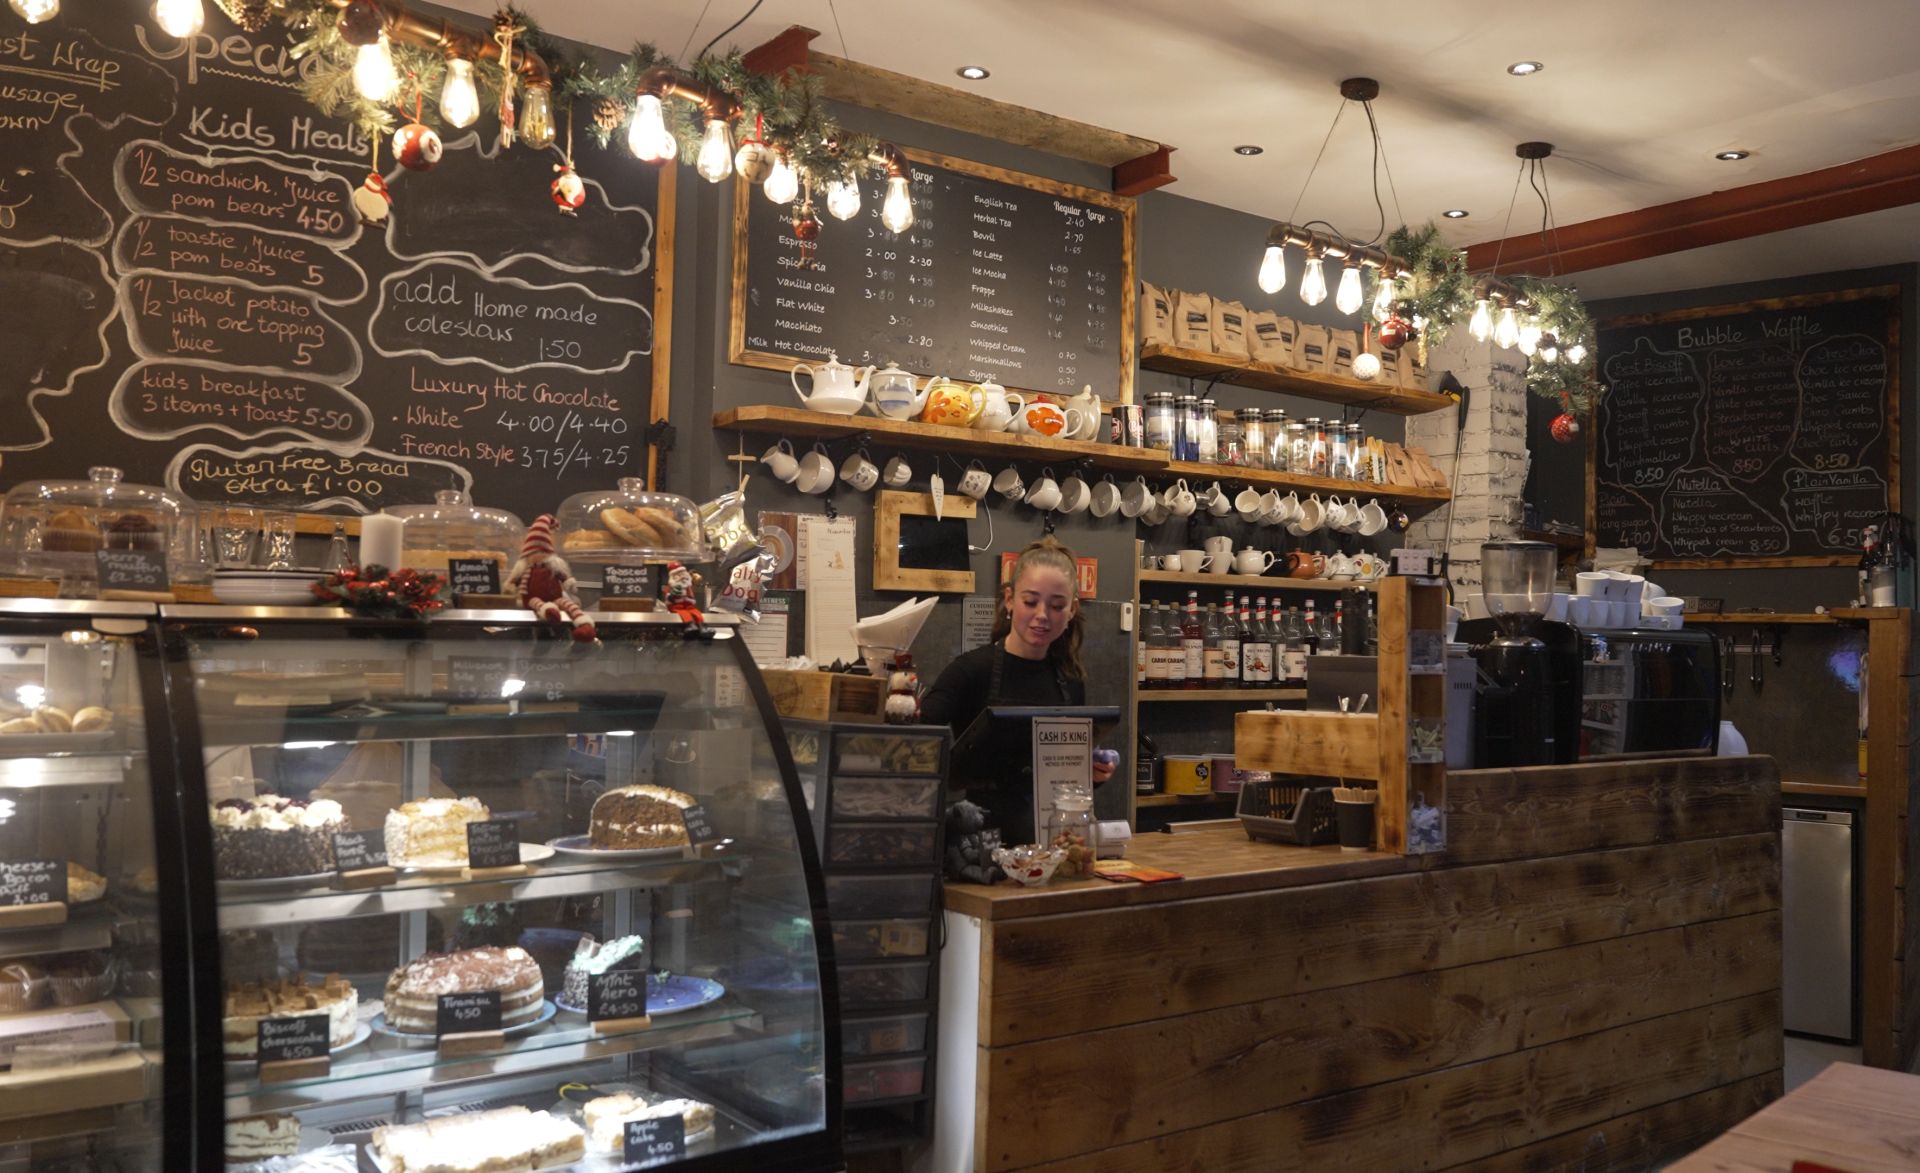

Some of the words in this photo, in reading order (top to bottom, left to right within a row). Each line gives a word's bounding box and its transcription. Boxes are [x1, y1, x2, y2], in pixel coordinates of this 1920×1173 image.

[52, 41, 120, 93] Wrap
[190, 106, 275, 145] Kids
[291, 116, 370, 156] Meals
[911, 168, 934, 184] Large
[974, 195, 1004, 209] English
[1005, 202, 1018, 212] Tea
[1053, 200, 1082, 216] Regular
[1086, 209, 1106, 223] Large
[172, 193, 215, 210] pom
[227, 198, 285, 219] bears
[296, 206, 344, 234] 4.50
[973, 213, 998, 225] Herbal
[999, 218, 1012, 228] Tea
[778, 235, 818, 250] Espresso
[972, 230, 996, 242] Bovril
[1064, 231, 1084, 243] 2.70
[865, 248, 897, 260] 2.00
[909, 256, 932, 267] 2.30
[972, 248, 983, 258] Ice
[984, 250, 1003, 262] Latte
[170, 250, 209, 269] pom
[220, 256, 276, 276] bears
[302, 264, 324, 286] 5
[972, 266, 982, 275] Ice
[983, 268, 1007, 280] Mocha
[777, 277, 812, 291] Vanilla
[814, 283, 835, 294] Chia
[971, 284, 996, 296] Frappe
[167, 280, 236, 307] Jacket
[247, 299, 310, 318] potato
[393, 272, 463, 305] add
[474, 292, 528, 318] Home
[535, 304, 597, 325] made
[776, 298, 796, 309] Flat
[798, 301, 825, 314] White
[970, 302, 1014, 317] Milkshakes
[172, 307, 207, 328] with
[217, 317, 253, 333] one
[258, 318, 325, 347] topping
[405, 315, 513, 341] coleslaw
[775, 319, 823, 334] Macchiato
[970, 320, 1009, 334] Smoothies
[1678, 325, 1747, 348] Bubble
[1762, 315, 1822, 352] Waffle
[540, 337, 582, 361] 1.50
[748, 336, 768, 348] Milk
[774, 339, 791, 350] Hot
[794, 341, 836, 356] Chocolate
[908, 335, 933, 347] 2.80
[969, 338, 1001, 351] Whipped
[1002, 343, 1026, 354] Cream
[292, 343, 316, 365] 5
[969, 354, 1022, 369] Marshmallows
[1714, 354, 1744, 369] Love
[1751, 350, 1796, 365] Struck
[1614, 359, 1641, 375] Best
[1644, 353, 1684, 376] Biscoff
[968, 369, 997, 382] Syrups
[142, 368, 189, 390] kids
[201, 375, 306, 405] breakfast
[411, 366, 487, 412] Luxury
[494, 377, 527, 402] Hot
[533, 383, 621, 412] Chocolate
[1613, 379, 1642, 398] Toffee
[1615, 393, 1648, 408] Vanilla
[1803, 392, 1829, 404] Choc
[142, 394, 158, 413] 3
[163, 395, 224, 416] items
[229, 404, 239, 416] +
[303, 407, 352, 430] 5.50
[407, 405, 463, 428] White
[1654, 406, 1686, 416] sauce
[1711, 409, 1784, 424] Strawberries
[1653, 418, 1690, 431] crumbs
[1799, 419, 1843, 436] Whipped
[1845, 421, 1879, 430] cream
[1618, 436, 1658, 456] Whipped
[1660, 436, 1689, 446] cream
[1731, 434, 1771, 447] WHITE
[400, 433, 470, 459] French
[476, 443, 515, 467] Style
[333, 457, 409, 477] Bread
[1619, 450, 1681, 469] Marshmallow
[1815, 453, 1850, 469] 8.50
[1634, 467, 1664, 484] 8.50
[1794, 470, 1828, 487] Plain
[1829, 473, 1869, 486] Vanilla
[302, 474, 382, 496] £1.00
[1677, 477, 1722, 491] Nutella
[1673, 498, 1717, 510] Nutella
[1622, 519, 1649, 534] sugar
[1619, 530, 1650, 547] 4.00
[1674, 536, 1711, 551] Whipped
[1715, 538, 1744, 546] cream
[1750, 539, 1780, 551] 8.50
[455, 561, 488, 573] Lemon
[605, 565, 648, 577] Toasted
[730, 566, 763, 584] alty
[613, 584, 643, 594] 2.50
[722, 583, 758, 604] Dog
[1039, 731, 1058, 742] CASH
[1060, 731, 1068, 742] IS
[1070, 731, 1088, 742] KING
[596, 973, 634, 987] Mint
[601, 987, 638, 999] Aero
[443, 996, 491, 1008] Tiramisu
[630, 1121, 659, 1135] Apple
[630, 1134, 656, 1145] cake
